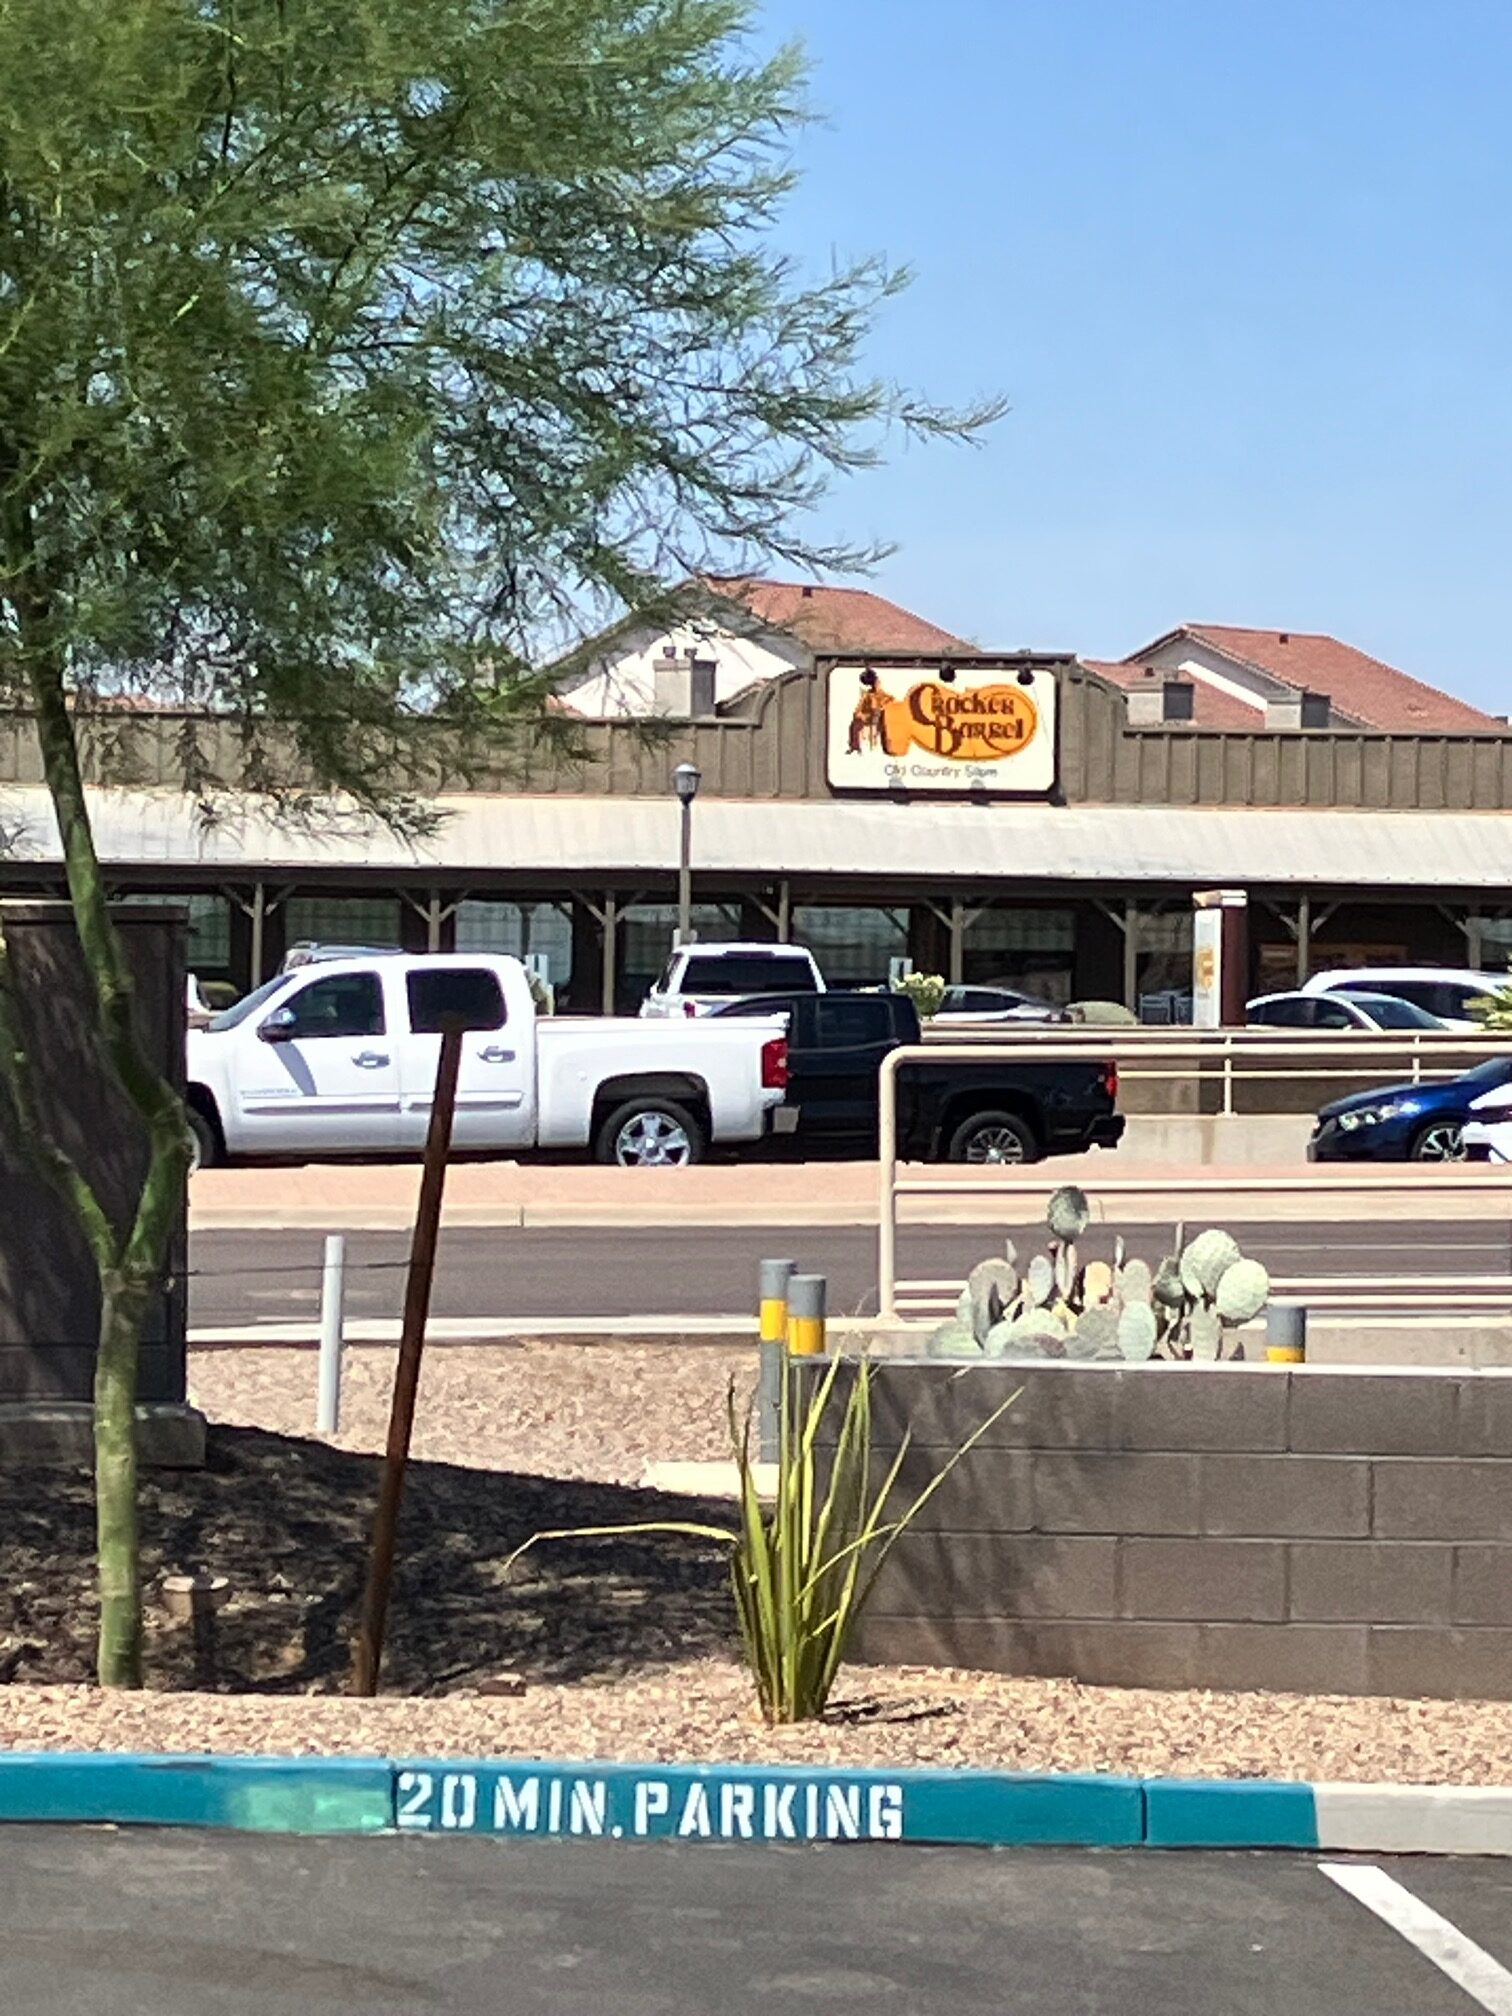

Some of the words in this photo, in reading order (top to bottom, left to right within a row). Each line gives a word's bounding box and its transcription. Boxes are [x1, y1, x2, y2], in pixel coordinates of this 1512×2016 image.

[909, 683, 1015, 727] Cracker
[935, 714, 1023, 757] Barrel
[397, 1772, 477, 1829] 20
[493, 1775, 624, 1839] MIN.
[634, 1780, 903, 1840] PARKING
